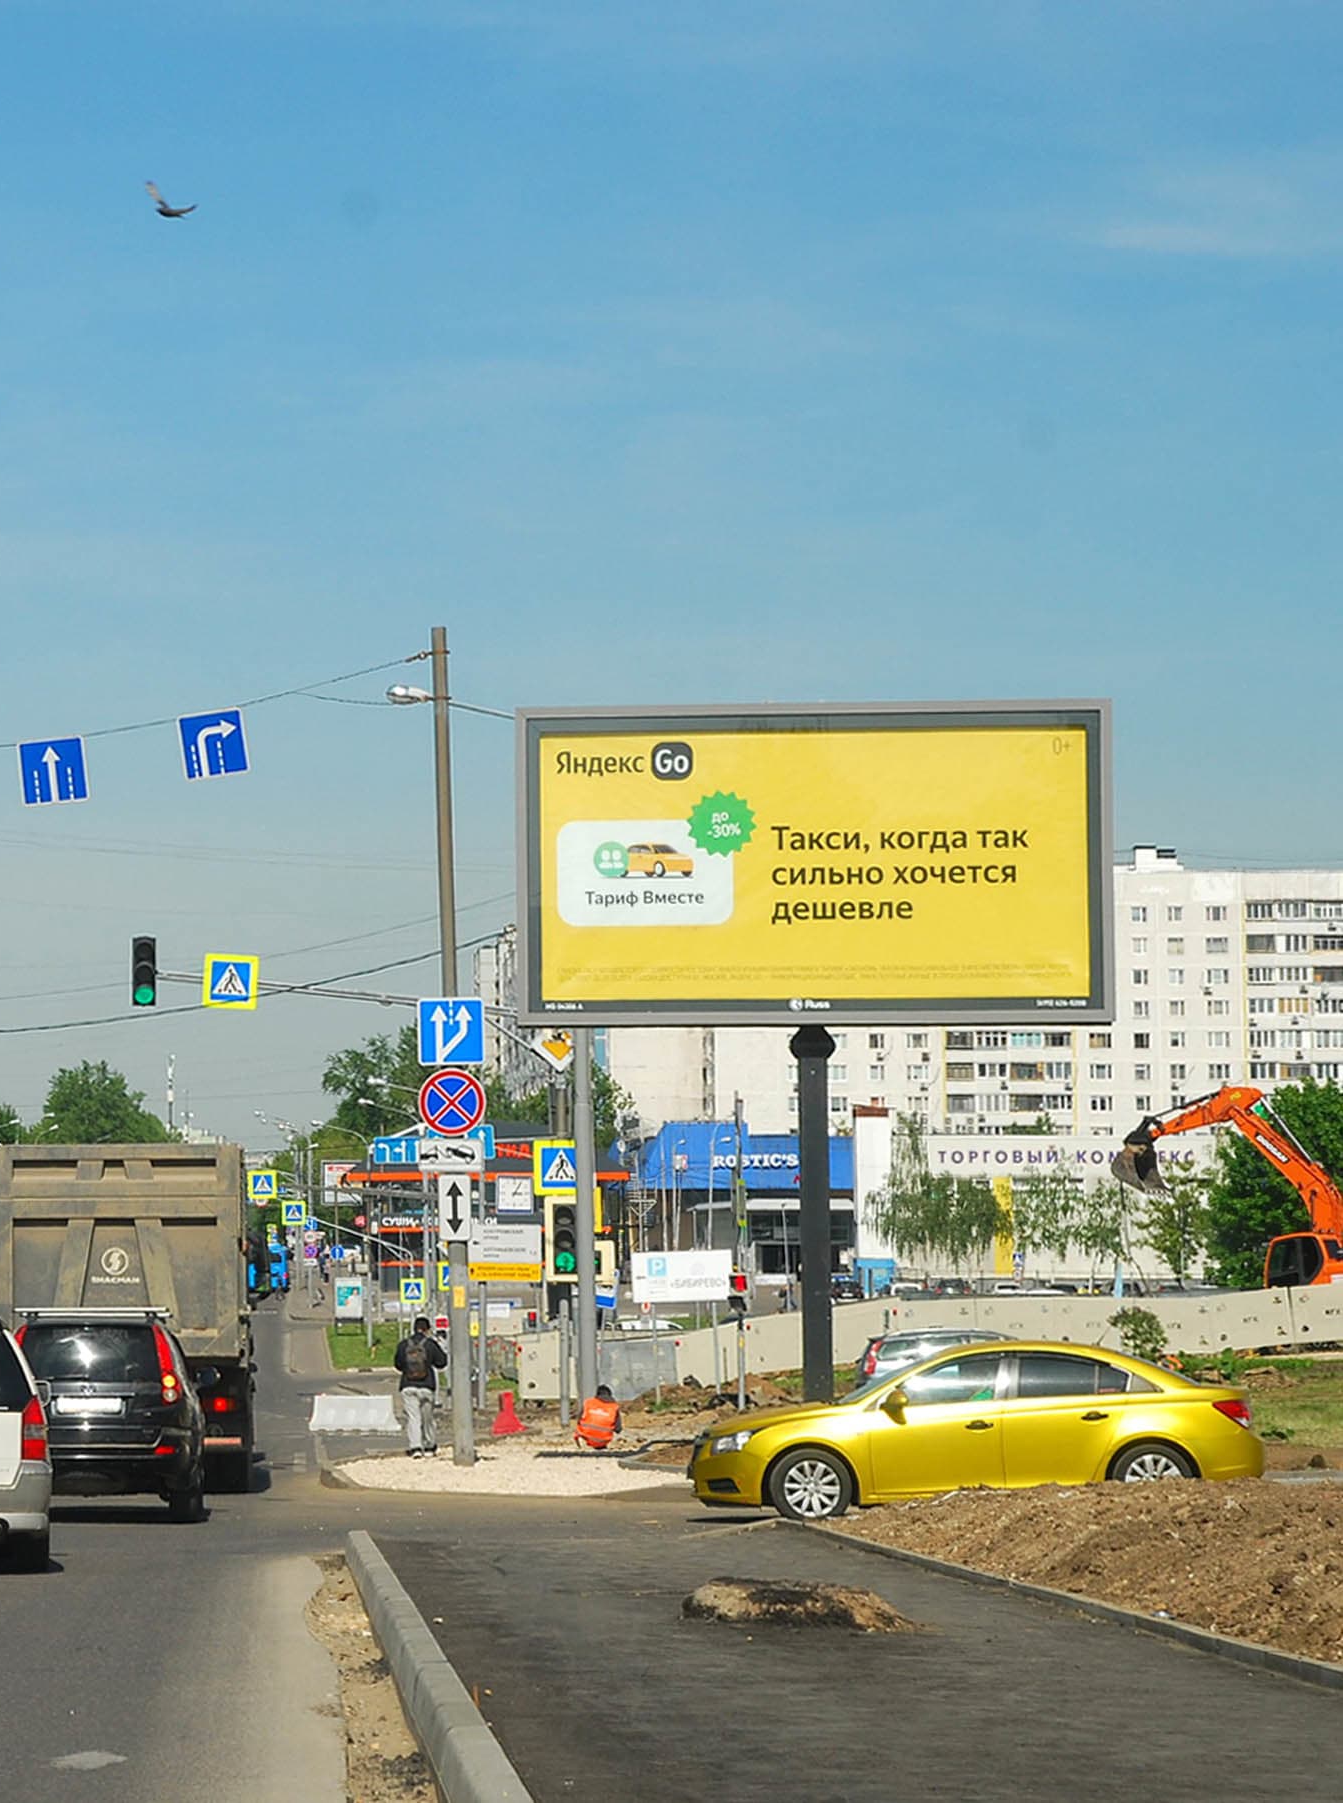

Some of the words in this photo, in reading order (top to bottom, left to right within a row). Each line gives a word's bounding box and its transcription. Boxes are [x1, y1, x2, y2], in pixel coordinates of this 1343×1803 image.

[556, 751, 645, 777] Яндекс
[655, 749, 689, 774] Go
[711, 812, 729, 825] до
[707, 823, 742, 838] -30%
[771, 825, 871, 853] Такси,
[880, 830, 968, 853] когда
[977, 829, 1029, 849] так
[771, 865, 884, 886] сильно
[893, 864, 1017, 885] хочется
[585, 891, 639, 907] Тариф
[643, 890, 704, 904] Вместе
[771, 900, 914, 925] дешевле
[712, 1153, 800, 1168] ROSTIC'S
[938, 1146, 1058, 1164] ТОРГОВЫЙ
[1077, 1150, 1194, 1164] КОМЕКС
